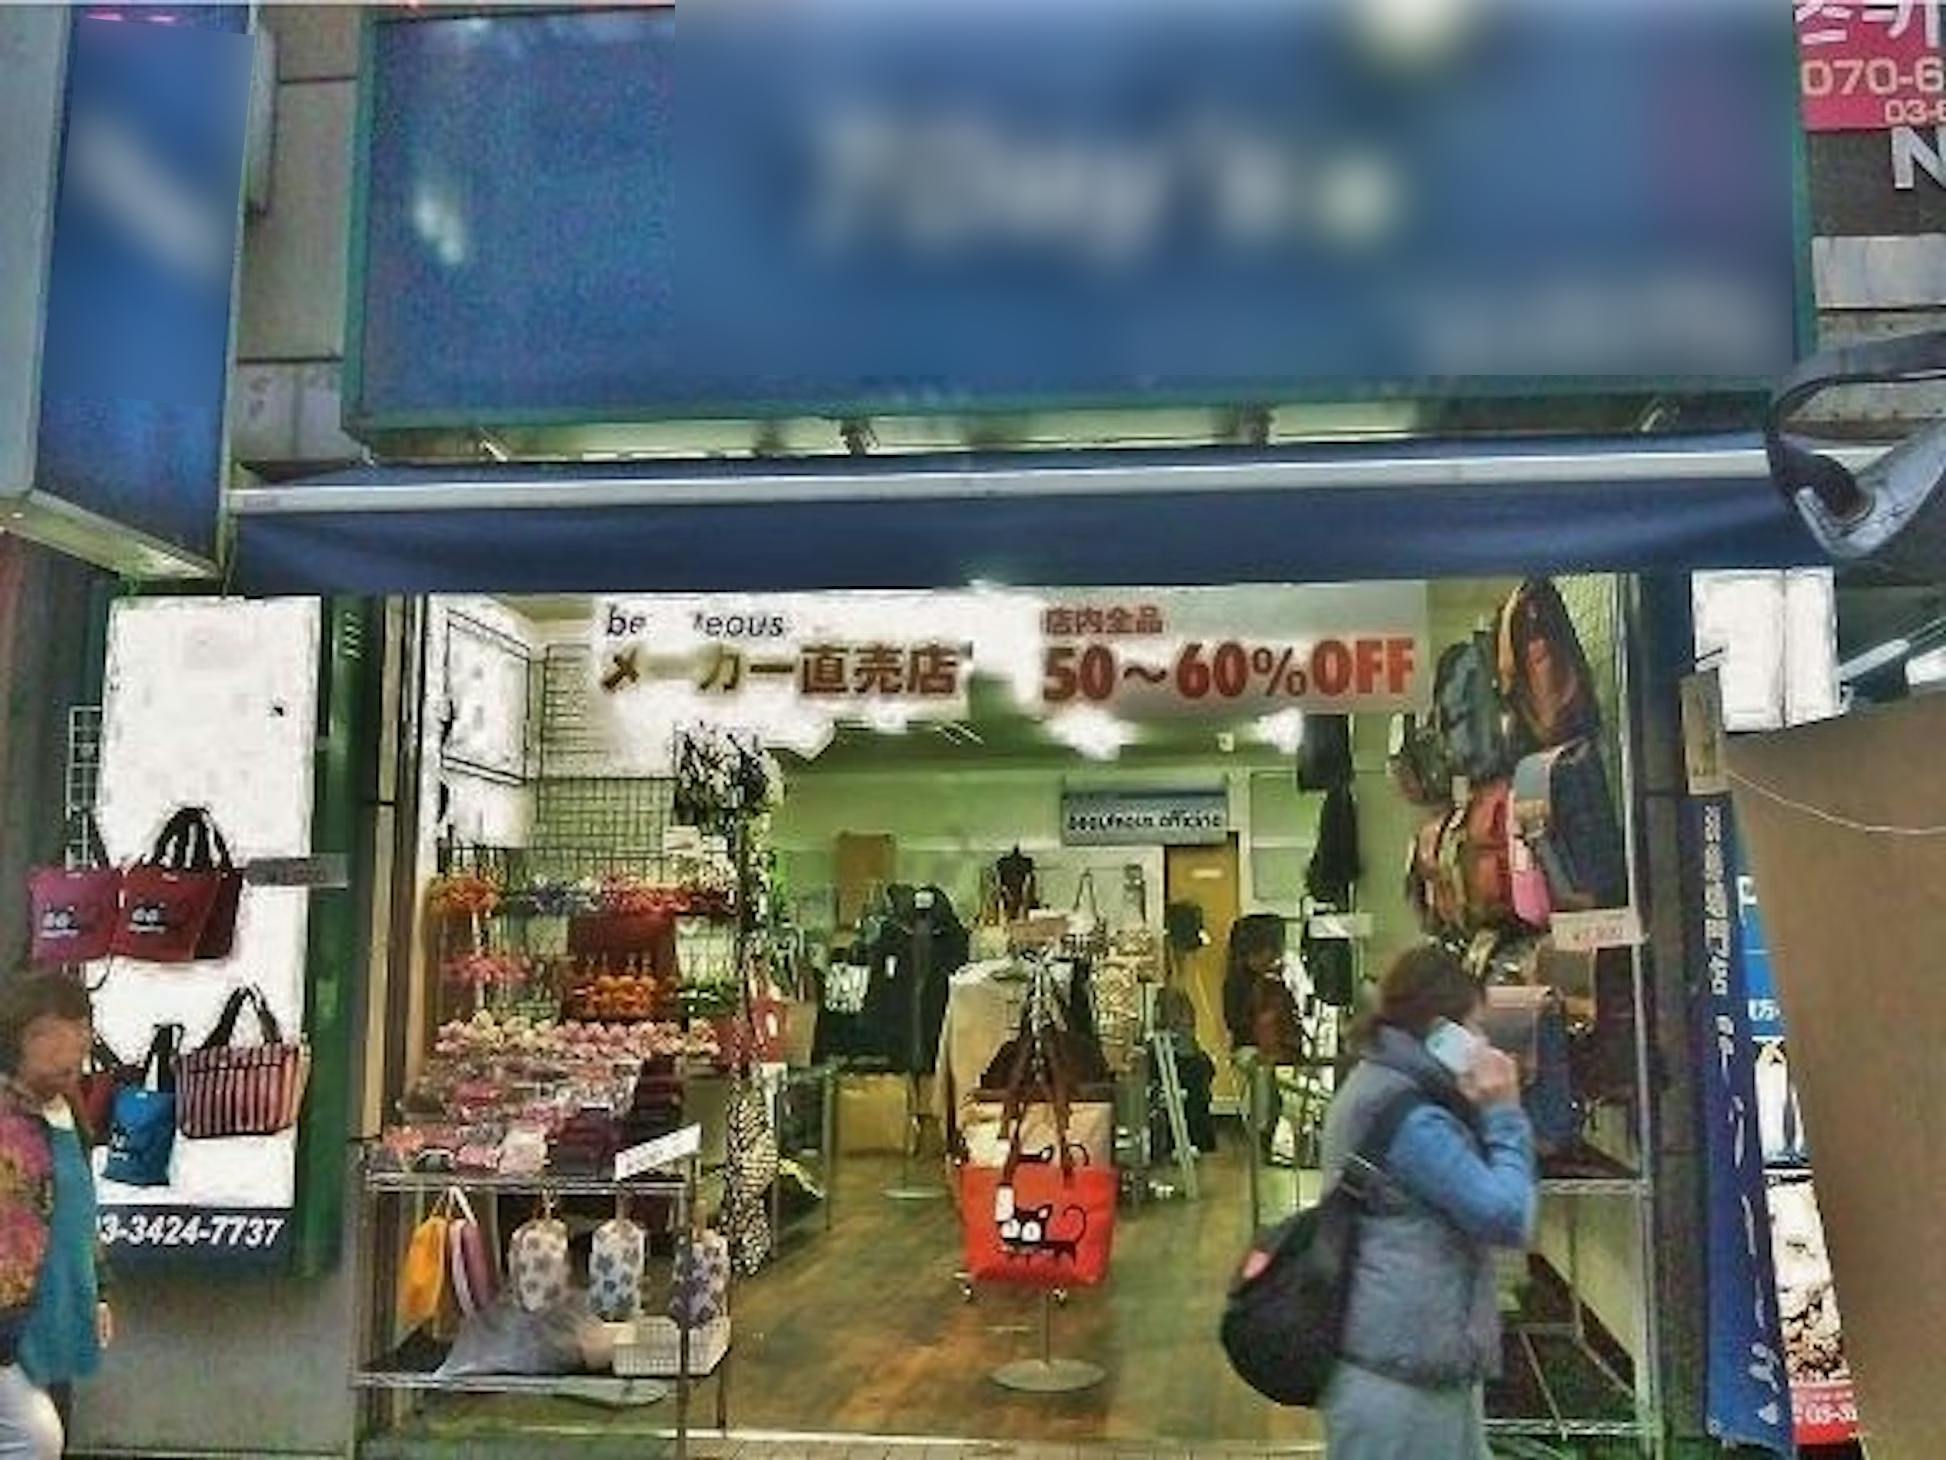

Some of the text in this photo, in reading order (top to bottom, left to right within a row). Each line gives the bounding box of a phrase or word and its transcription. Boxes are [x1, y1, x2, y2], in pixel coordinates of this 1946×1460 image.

[1802, 57, 1945, 96] 070-6
[606, 604, 784, 637] beeous
[1044, 605, 1164, 635] 店内全品
[602, 641, 958, 696] メカー直売店
[95, 1211, 286, 1248] 3-3424-7737
